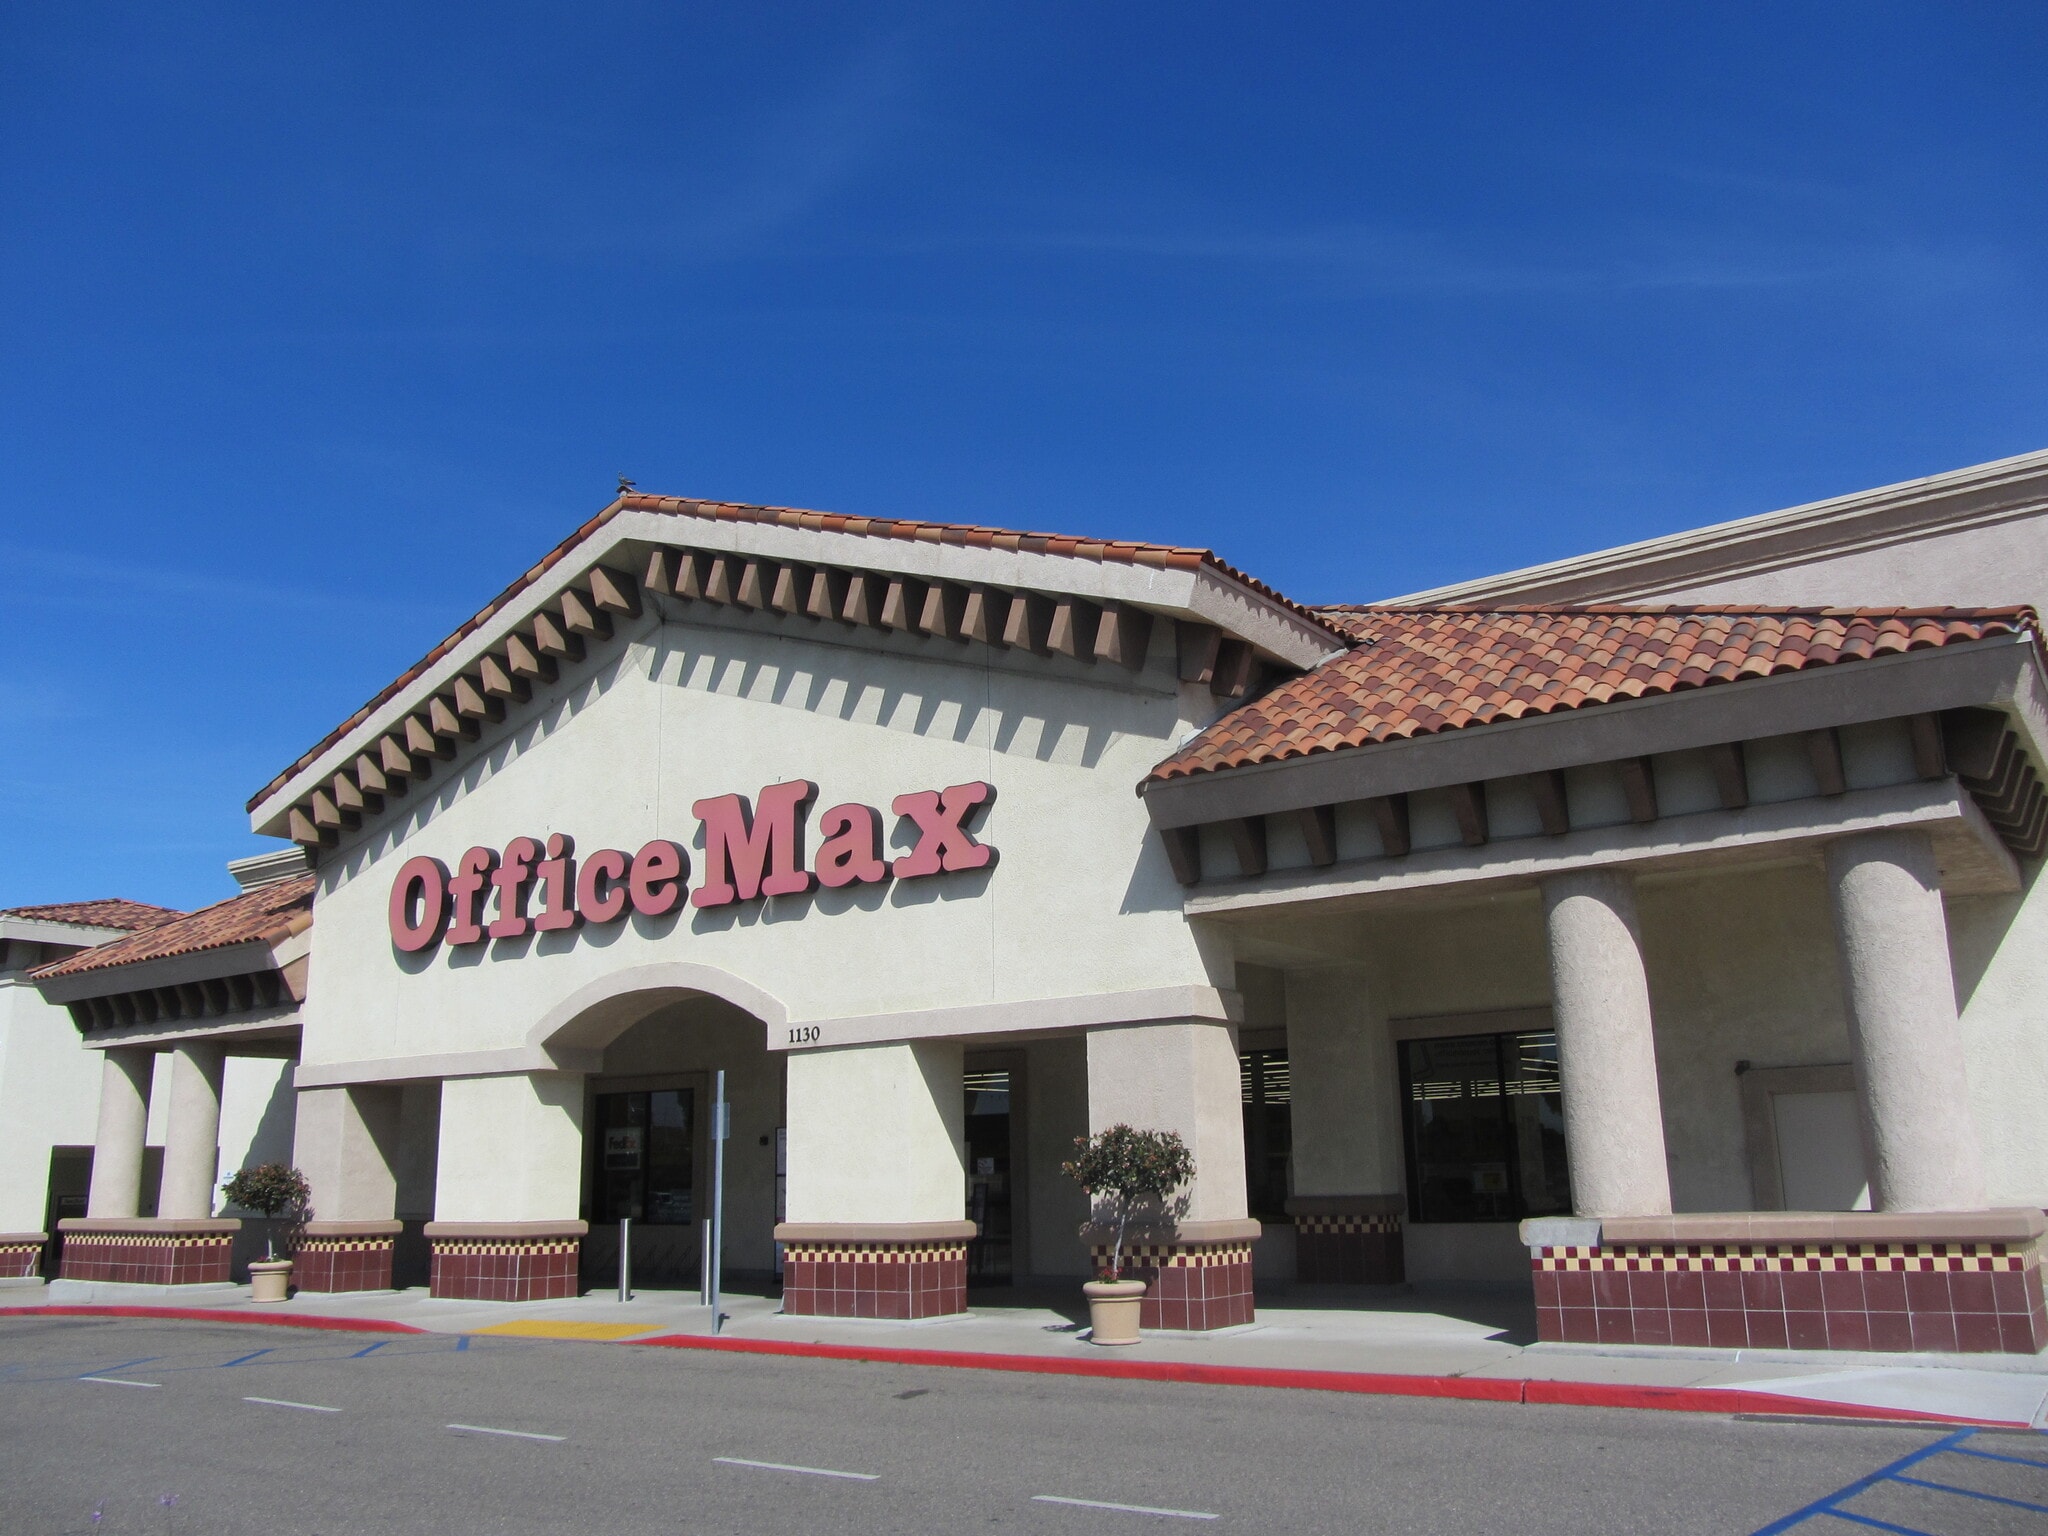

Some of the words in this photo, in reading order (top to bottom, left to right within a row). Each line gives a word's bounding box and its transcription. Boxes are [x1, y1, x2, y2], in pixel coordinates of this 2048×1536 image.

[389, 779, 1000, 953] OfficeMax
[789, 1026, 820, 1043] 1130
[608, 1135, 636, 1150] FedEx
